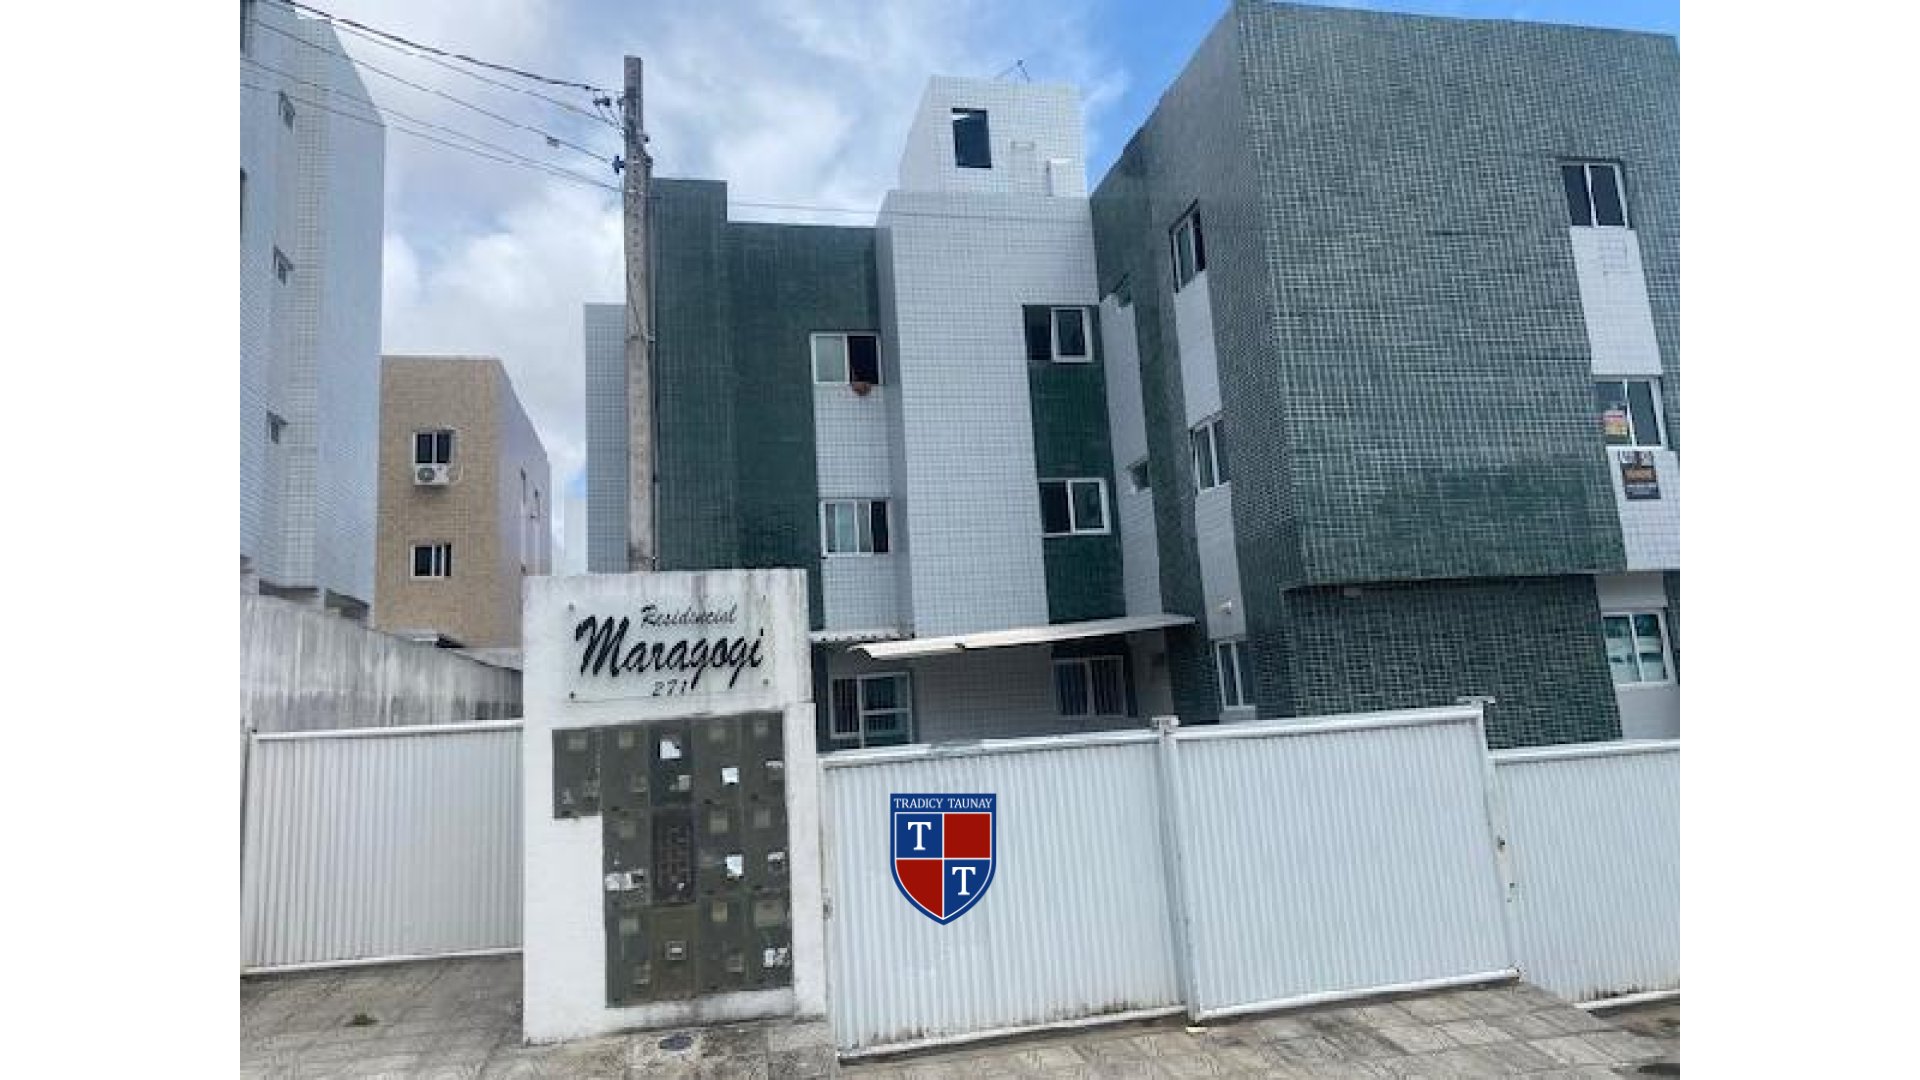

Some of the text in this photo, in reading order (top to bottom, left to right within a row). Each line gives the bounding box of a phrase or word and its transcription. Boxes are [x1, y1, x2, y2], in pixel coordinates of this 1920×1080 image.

[641, 604, 737, 627] Residencial
[576, 615, 763, 689] Maragogi
[652, 679, 687, 696] 271
